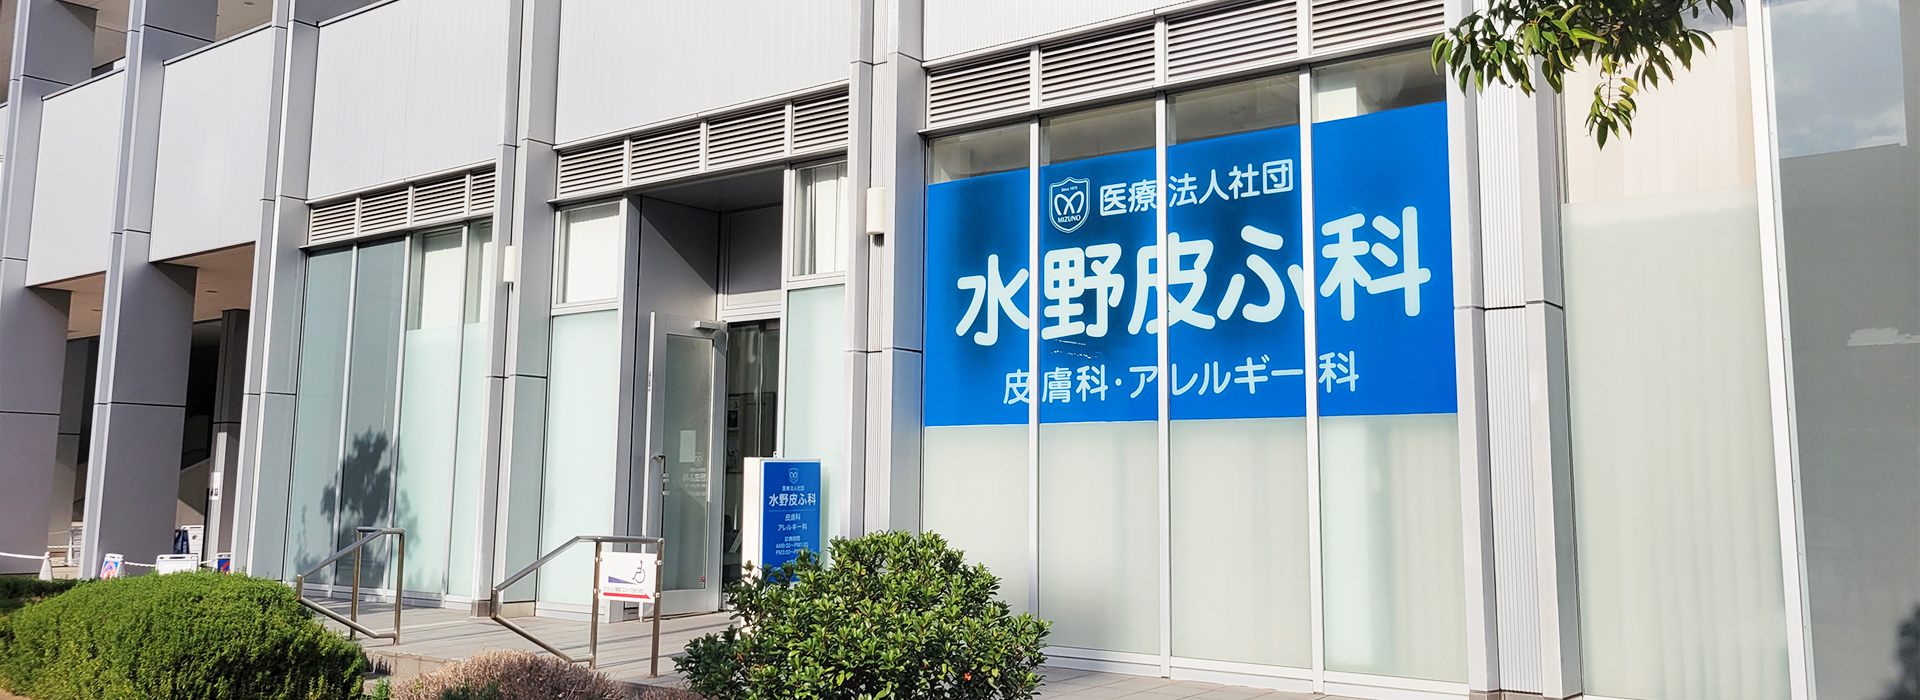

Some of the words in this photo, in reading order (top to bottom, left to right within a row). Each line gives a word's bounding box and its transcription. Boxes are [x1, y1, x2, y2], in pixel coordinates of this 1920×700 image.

[1100, 159, 1294, 217] 医療法人社団
[1057, 214, 1082, 223] MIZUNO
[956, 206, 1431, 346] 水野皮ふ科
[768, 492, 816, 507] 水野皮ふ科
[778, 522, 808, 531] アレルギー科
